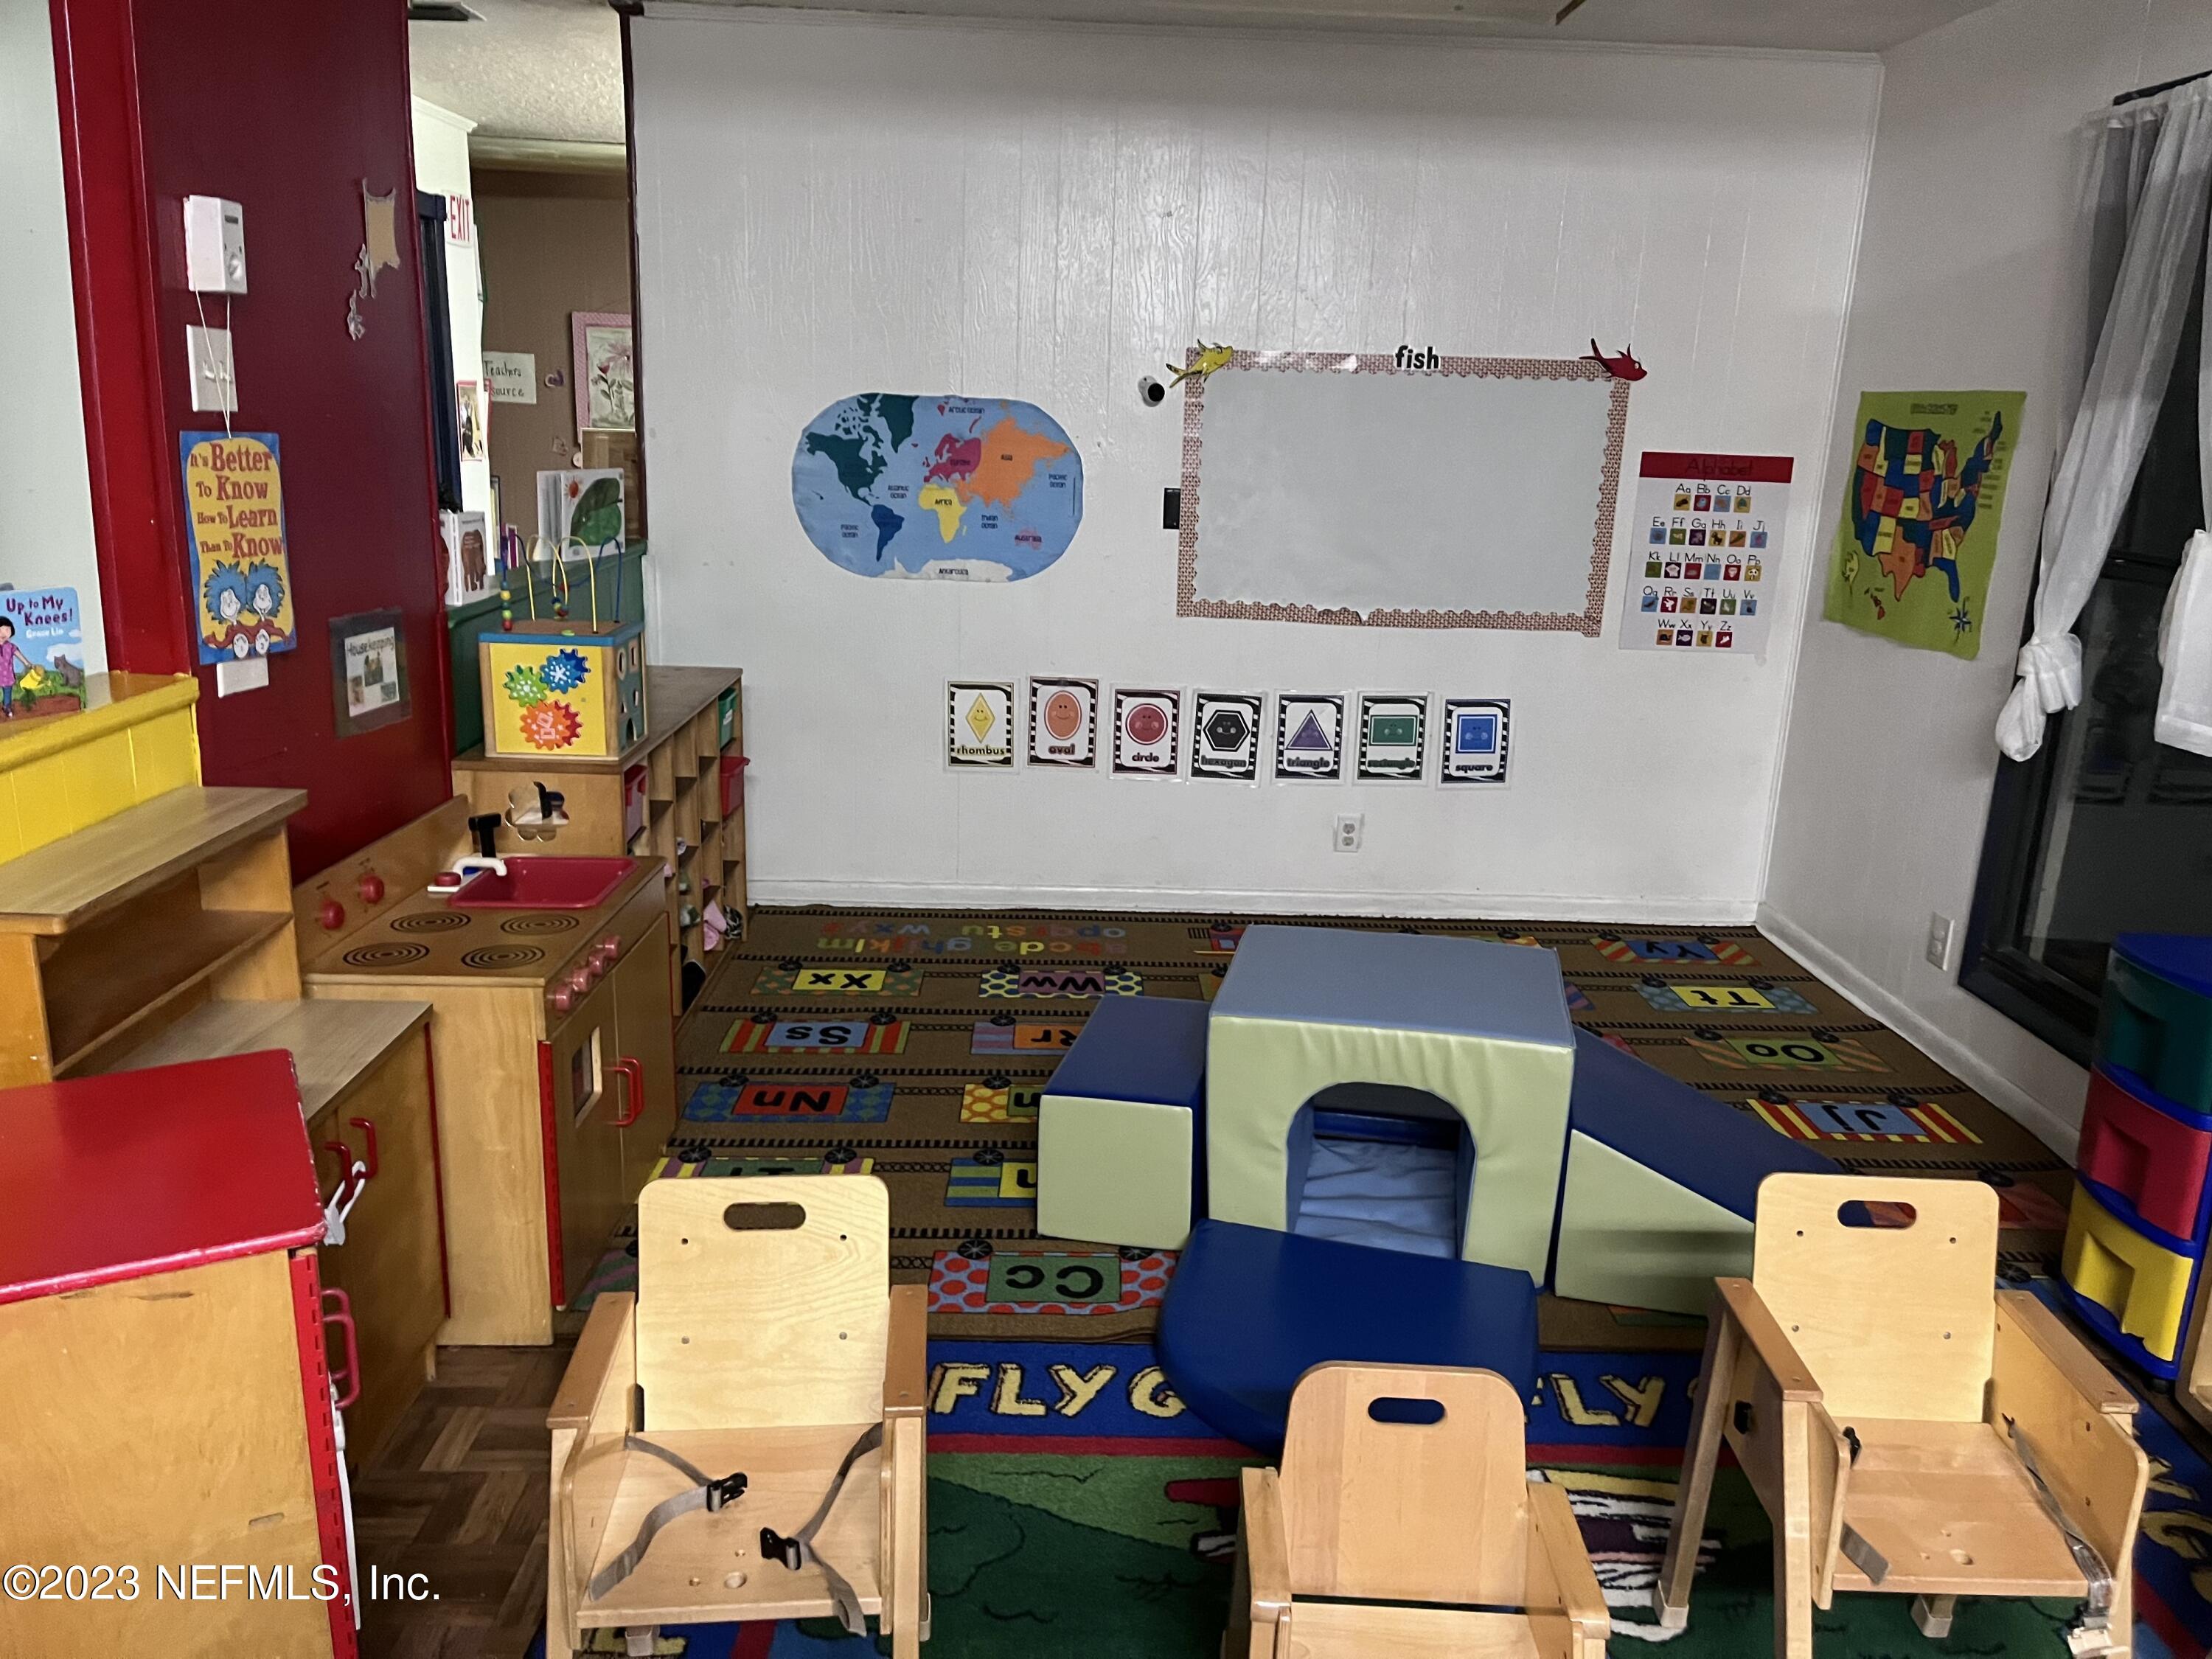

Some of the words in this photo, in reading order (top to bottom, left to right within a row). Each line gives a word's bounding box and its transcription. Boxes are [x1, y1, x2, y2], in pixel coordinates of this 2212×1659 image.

[450, 193, 470, 243] EXIT
[1395, 345, 1439, 369] fish
[209, 442, 273, 472] Better
[1686, 457, 1754, 481] Alphabet
[195, 481, 212, 498] To
[215, 474, 268, 501] Know
[1675, 483, 1691, 494] Aa
[1697, 484, 1711, 494] Bb
[1717, 484, 1731, 495] Cc
[1736, 485, 1751, 496] Dd
[197, 512, 216, 524] How
[226, 504, 278, 529] Learn
[1652, 517, 1666, 528] Ee
[1672, 518, 1686, 527] Ff
[1691, 518, 1707, 531] Gg
[1711, 519, 1726, 530] Hh
[1736, 520, 1743, 530] Ii
[1752, 521, 1765, 533] Jj
[232, 532, 283, 558] Know
[1648, 552, 1661, 561] Kk
[1669, 552, 1680, 562] Ll
[1684, 553, 1704, 563] Mm
[1706, 554, 1721, 563] Nn
[1726, 554, 1742, 564] Oo
[1747, 555, 1761, 567] Pp
[1643, 585, 1658, 598] Qq
[1663, 586, 1677, 597] Rr
[1684, 587, 1695, 597] Ss
[1703, 588, 1715, 598] Tt
[1722, 588, 1736, 599] Uu
[1743, 589, 1756, 599] Vv
[6, 597, 25, 615] Up
[29, 597, 39, 609] to
[42, 594, 63, 611] My
[24, 608, 73, 626] Knees!
[1658, 619, 1676, 629] Ww
[1680, 619, 1692, 629] Xx
[1700, 620, 1713, 632] Yy
[1719, 621, 1732, 631] Zz
[956, 744, 1005, 755] rhombus
[1048, 744, 1076, 756] oval
[1132, 752, 1160, 763] circle
[1201, 755, 1246, 768] hexagon
[1287, 757, 1330, 770] triangle
[1455, 763, 1493, 773] square
[928, 1363, 1118, 1418] FLY
[1525, 1373, 1666, 1427] LY
